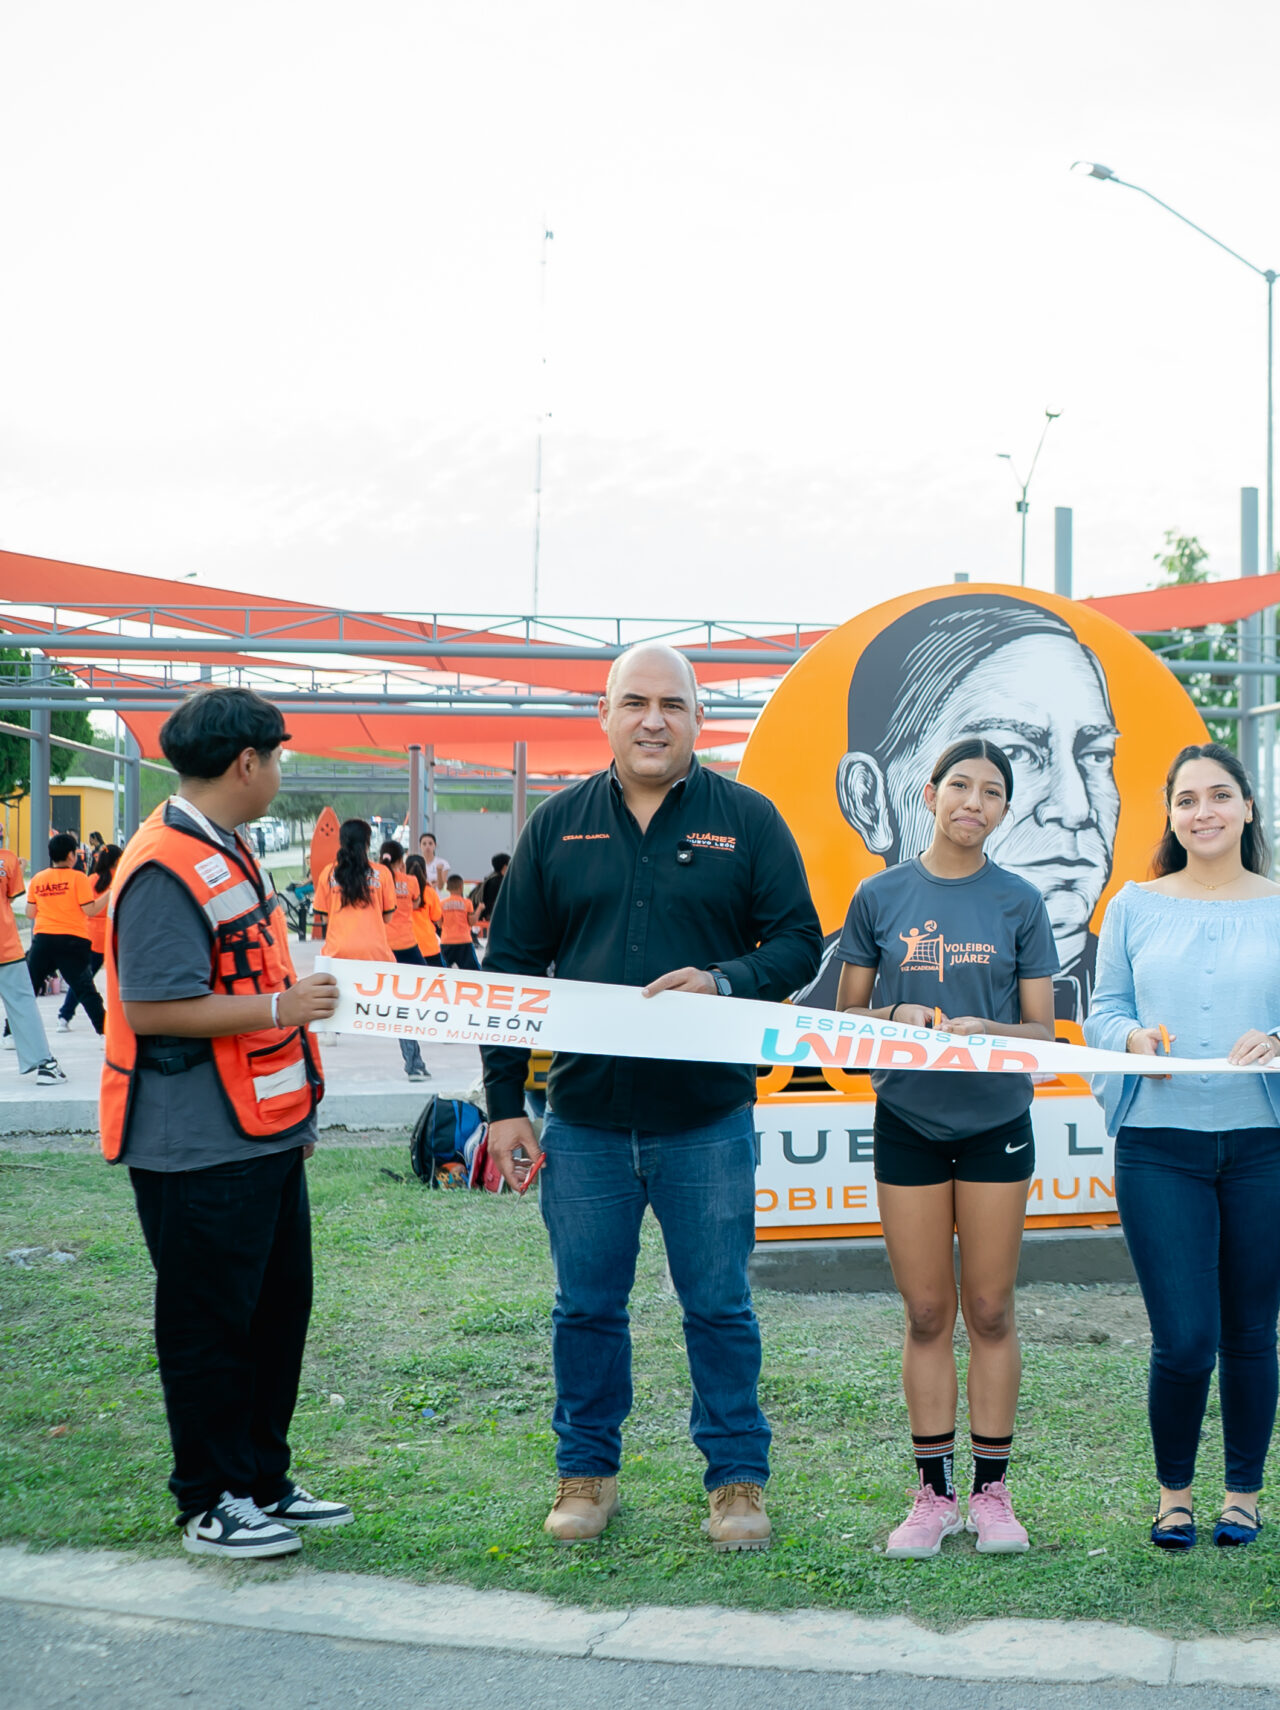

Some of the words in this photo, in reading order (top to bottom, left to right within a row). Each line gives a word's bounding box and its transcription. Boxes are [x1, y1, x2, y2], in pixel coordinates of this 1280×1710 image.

[686, 832, 737, 845] JUÁREZ
[944, 942, 997, 954] VOLEIBOL
[949, 952, 990, 966] JUÁREZ
[353, 972, 551, 1014] JUÁREZ
[355, 1002, 449, 1023] NUEVO
[468, 1013, 543, 1032] LEÓN
[353, 1020, 438, 1036] GOBIERNO
[446, 1029, 538, 1045] MUNICIPAL
[795, 1015, 951, 1042] ESPACIOS
[968, 1034, 1008, 1047] DE
[760, 1028, 1039, 1072] UNIDAD
